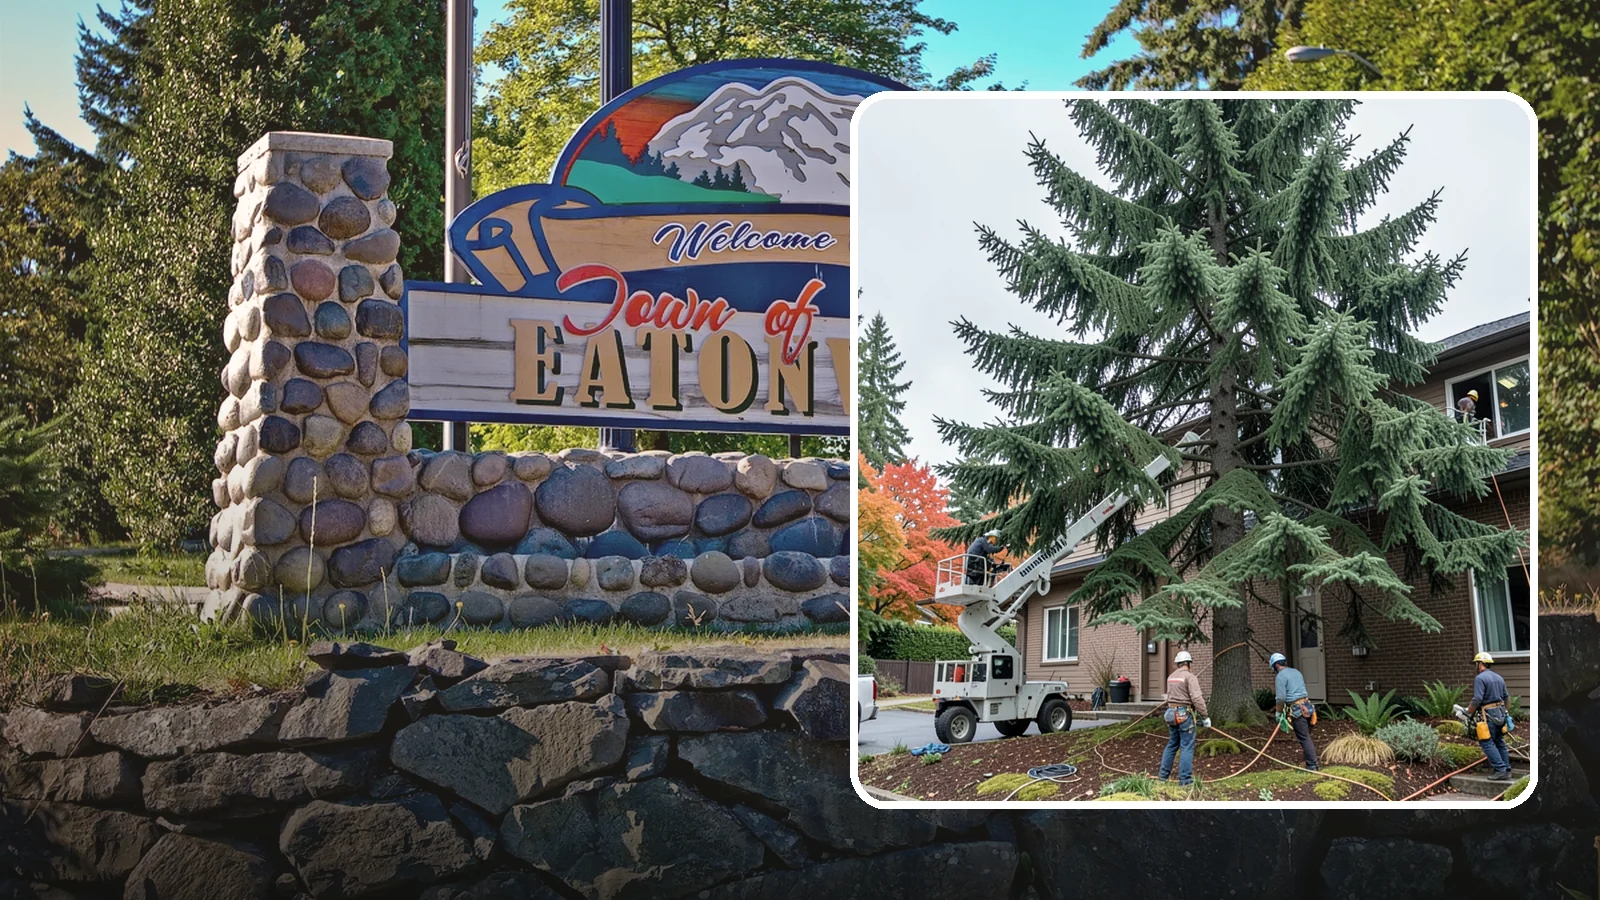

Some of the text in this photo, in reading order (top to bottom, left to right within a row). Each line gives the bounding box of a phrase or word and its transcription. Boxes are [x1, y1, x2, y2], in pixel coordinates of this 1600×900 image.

[653, 220, 837, 263] Welcome
[557, 264, 826, 365] Town of
